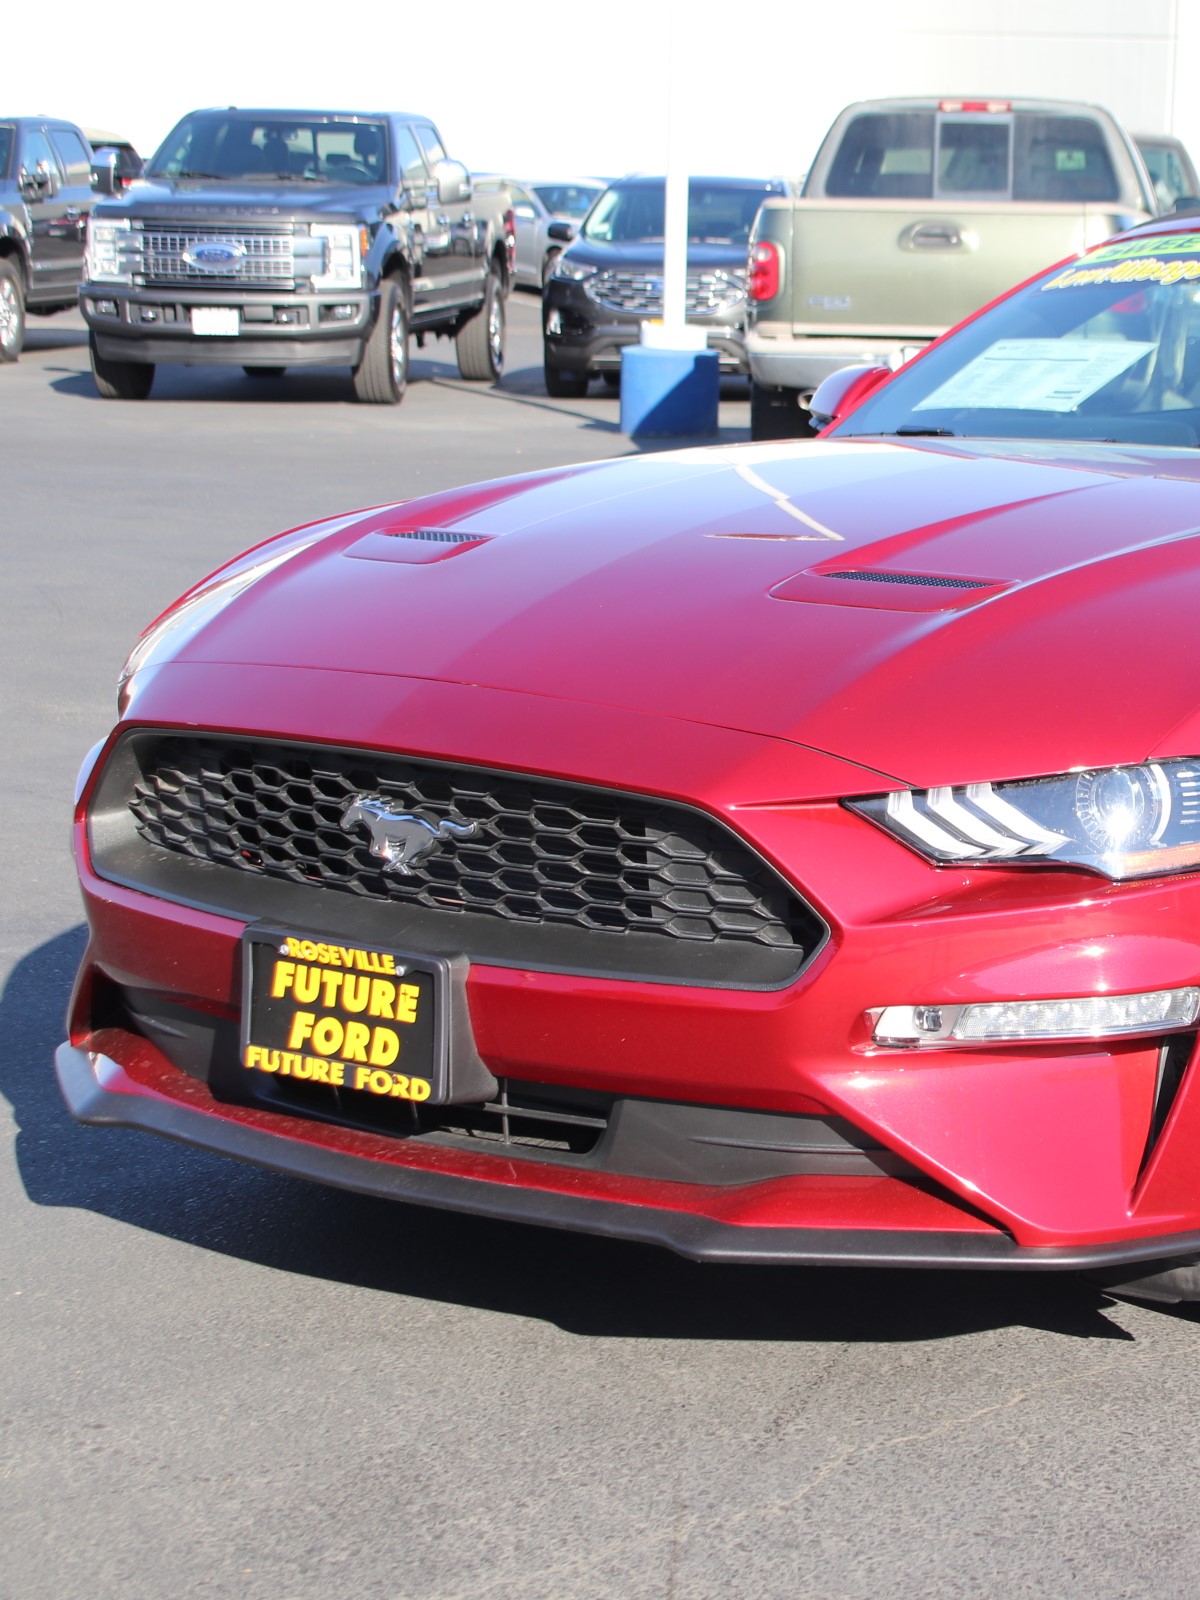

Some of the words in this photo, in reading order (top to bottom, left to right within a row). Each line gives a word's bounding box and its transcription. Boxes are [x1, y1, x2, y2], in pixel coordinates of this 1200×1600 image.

[285, 936, 396, 976] ROSEVILLE
[271, 960, 420, 1024] FUTURE
[288, 1010, 400, 1068] FORD
[245, 1045, 345, 1086] FUTURE
[354, 1065, 431, 1102] FORD
